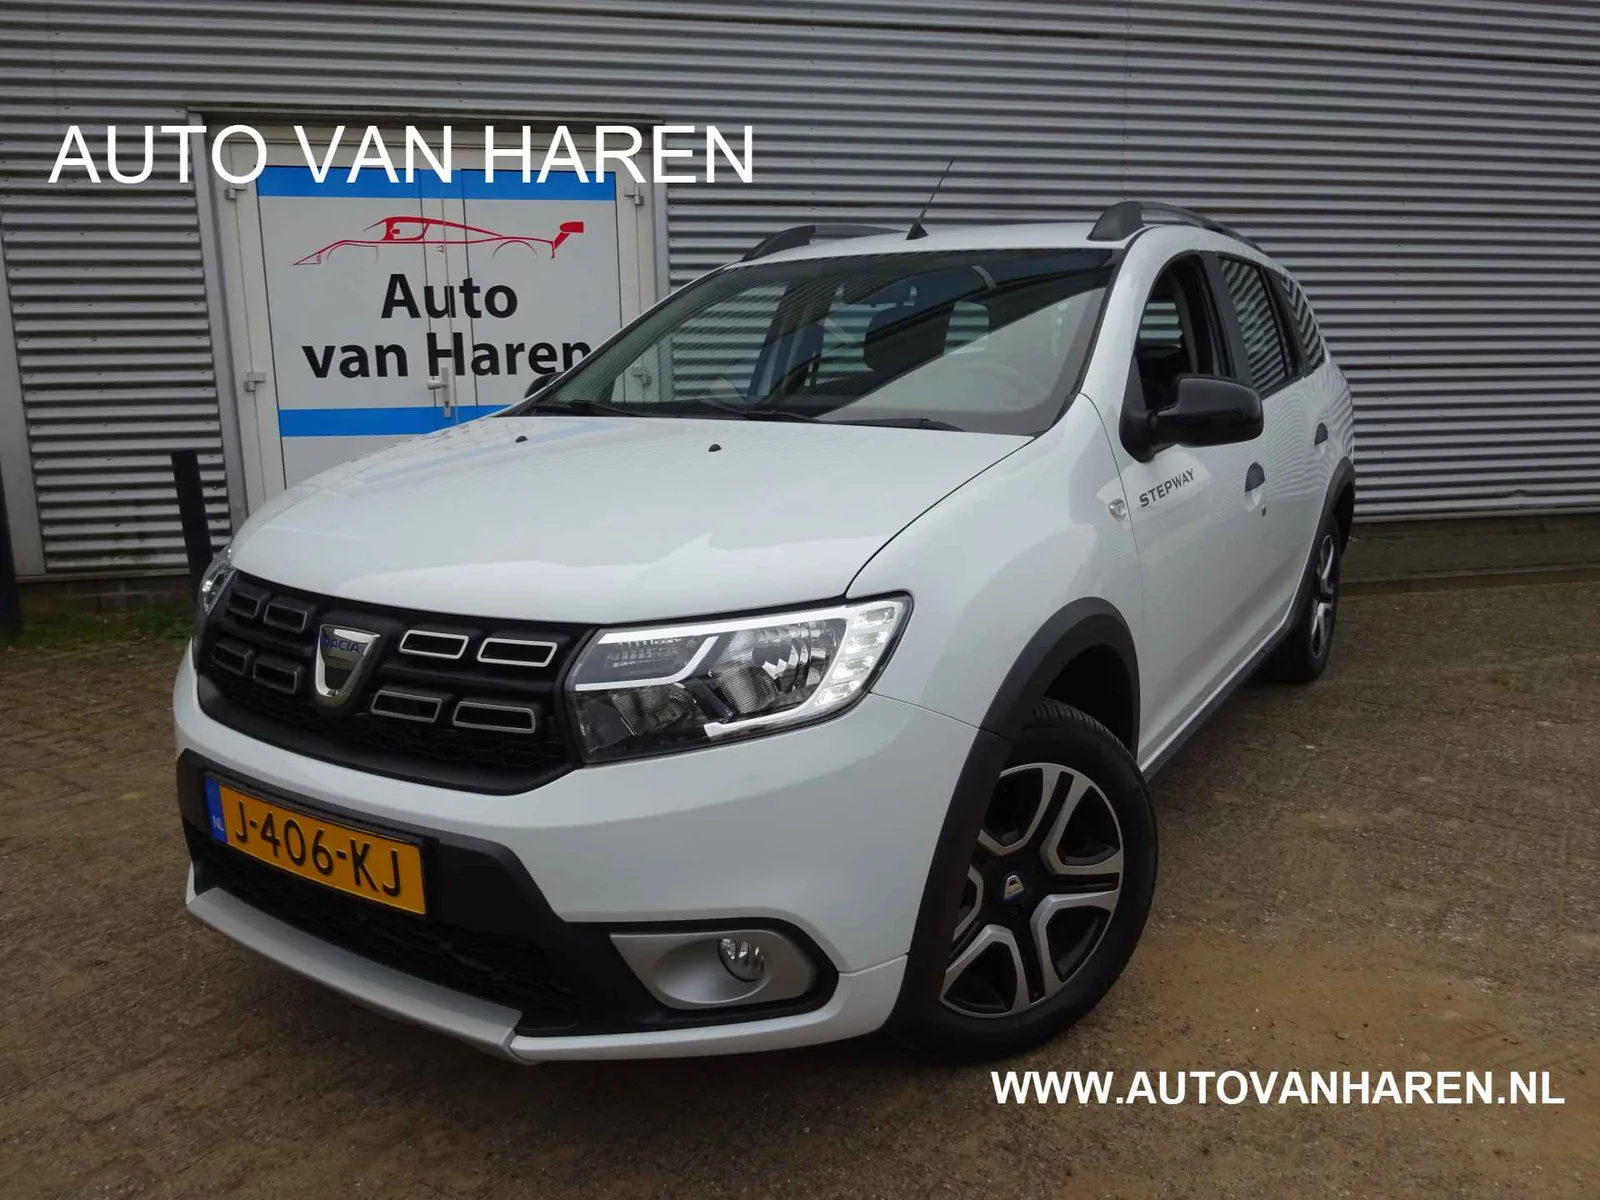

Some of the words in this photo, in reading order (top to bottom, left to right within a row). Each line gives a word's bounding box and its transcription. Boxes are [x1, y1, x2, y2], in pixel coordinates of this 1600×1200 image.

[381, 273, 518, 319] Auto
[302, 343, 409, 379] van
[426, 331, 592, 377] Haren
[1139, 468, 1195, 508] STEPWAY
[234, 800, 402, 898] J-406-KJ
